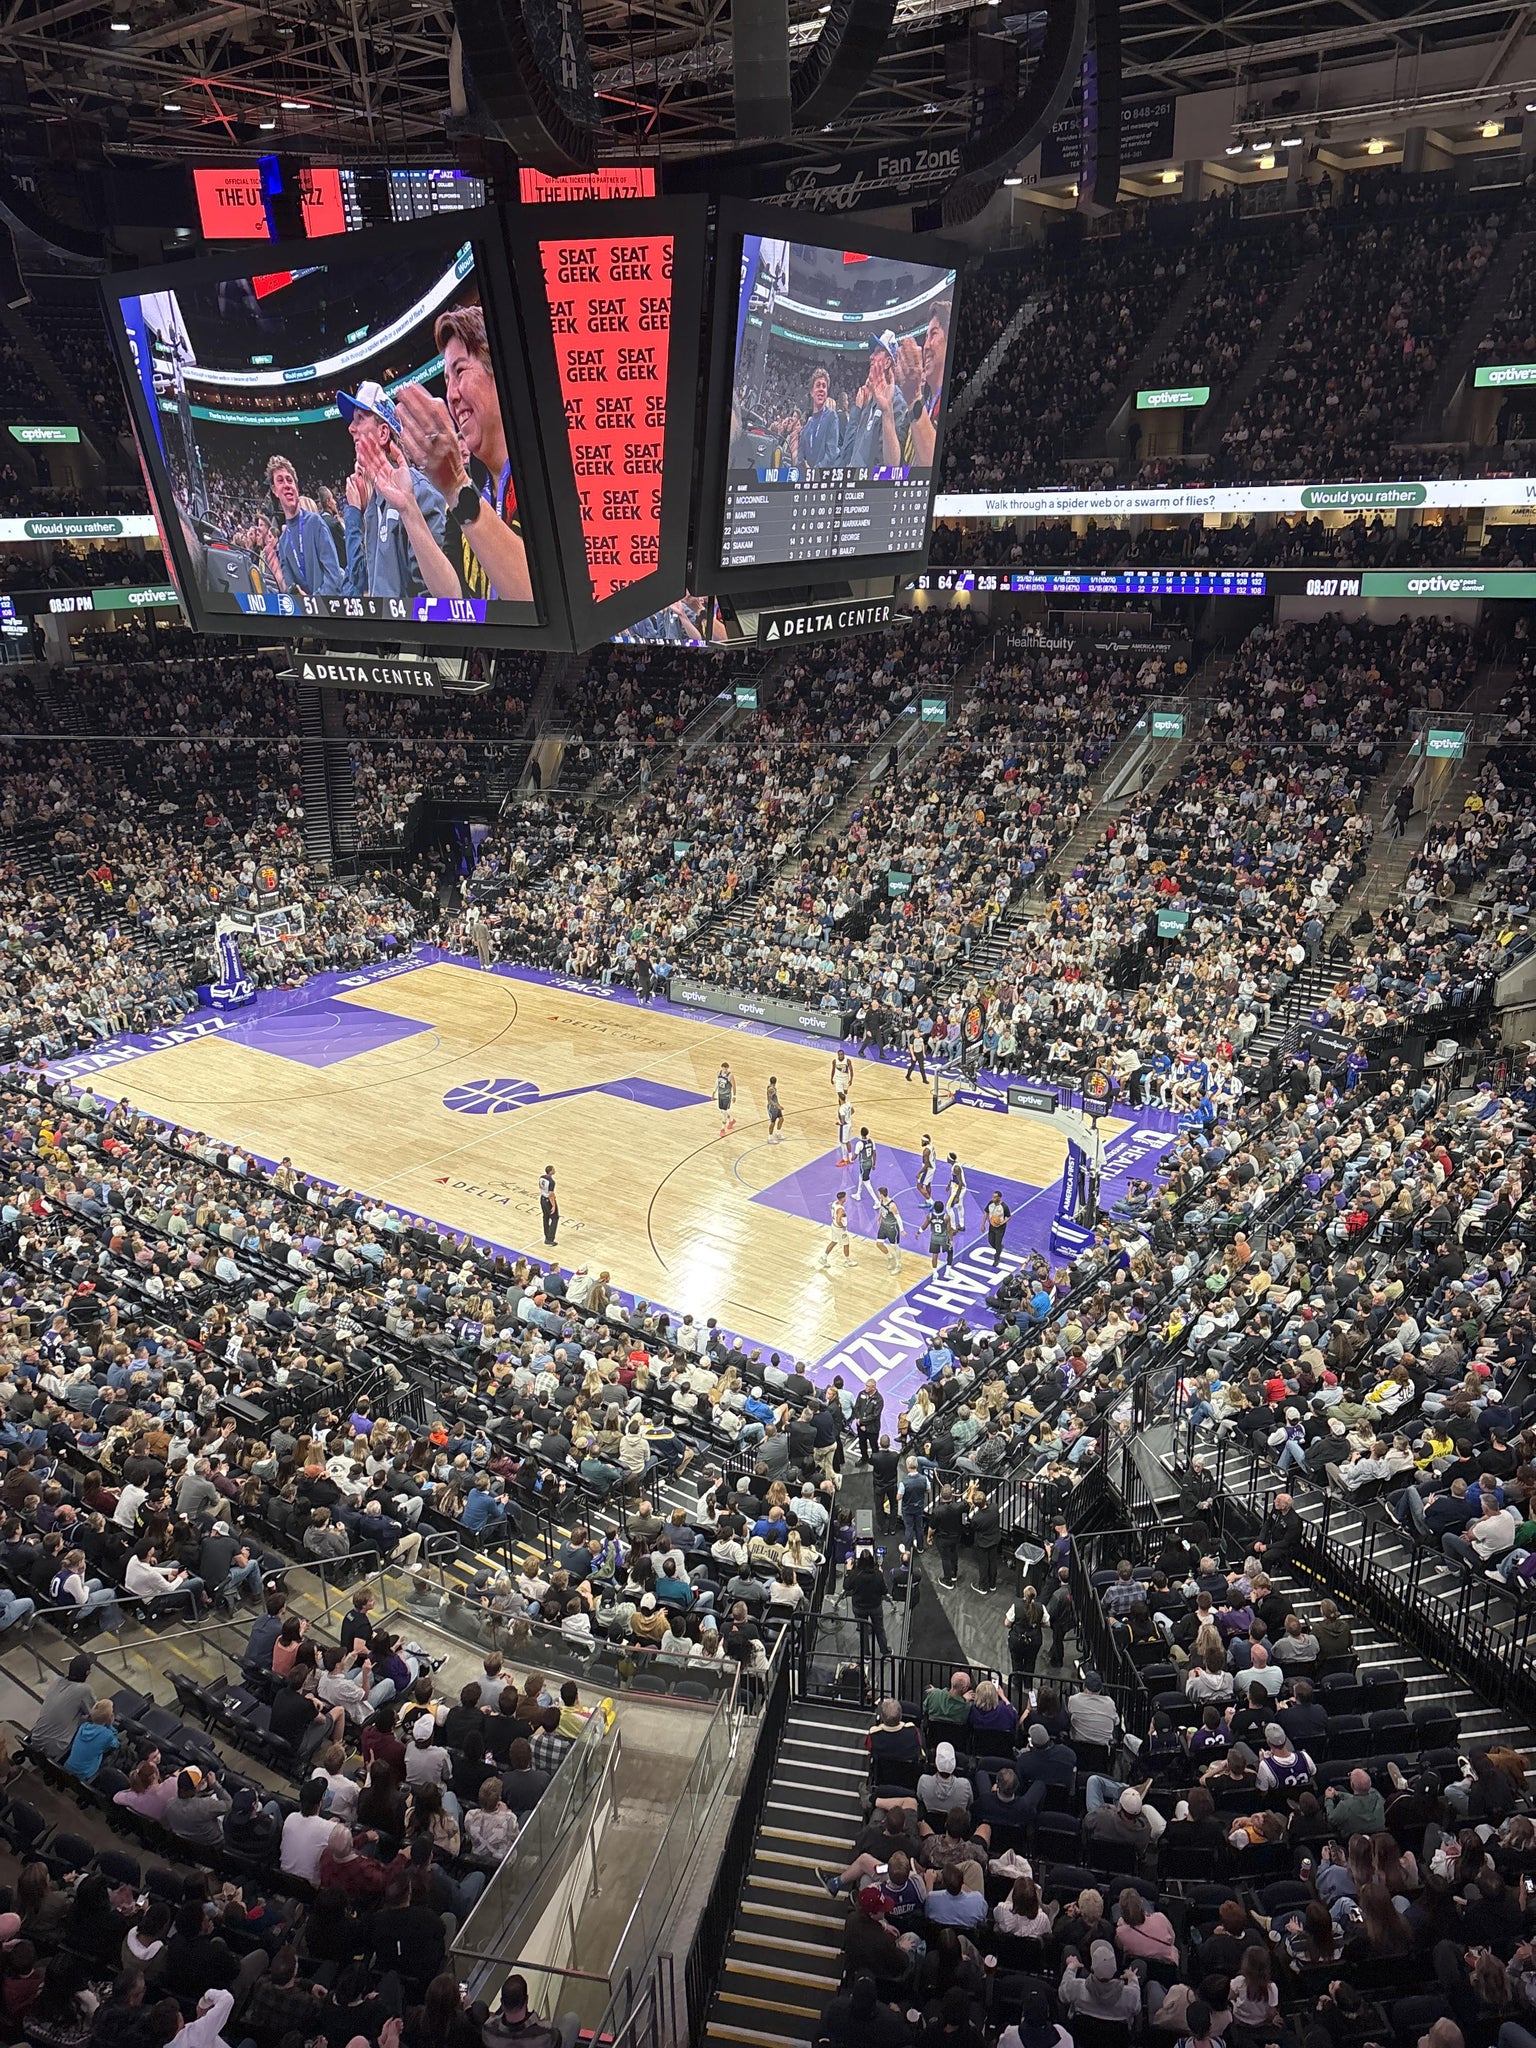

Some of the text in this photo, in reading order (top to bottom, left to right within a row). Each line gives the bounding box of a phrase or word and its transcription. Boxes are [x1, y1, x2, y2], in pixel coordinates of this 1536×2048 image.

[556, 0, 577, 90] TAH
[1133, 104, 1170, 118] 848-261
[1052, 120, 1068, 132] EXT
[878, 148, 960, 177] Fan Zone
[215, 188, 245, 206] THE
[559, 248, 597, 265] SEAT
[610, 246, 648, 263] SEAT
[558, 266, 600, 283] GEEK
[609, 264, 652, 281] GEEK
[588, 299, 626, 315] SEAT
[551, 315, 669, 333] EEK GEEK GEE
[567, 348, 655, 365] SEAT SEAT
[566, 365, 658, 382] GEEK GEEK
[1489, 368, 1529, 384] aptive
[565, 396, 664, 413] AT SEAT SE
[1147, 391, 1180, 406] aptive
[567, 413, 665, 430] EK GEEK GE
[22, 429, 53, 440] aptive
[575, 443, 661, 460] SEAT SEAT
[574, 460, 662, 475] GEEK GEEK
[765, 469, 778, 482] IND
[806, 469, 815, 481] 51
[832, 468, 843, 480] 2:35
[859, 468, 868, 480] 64
[891, 467, 903, 480] UTA
[603, 490, 638, 504] SEAT
[736, 492, 864, 504] MCCONNELL COLLIER
[986, 499, 1008, 510] Walk
[1010, 498, 1047, 511] through
[1057, 497, 1089, 510] spider
[1090, 497, 1112, 507] web
[1113, 499, 1125, 507] or
[1126, 499, 1133, 507] a
[1135, 498, 1171, 507] swarm
[1173, 496, 1184, 506] of
[1186, 495, 1215, 506] flies?
[1311, 490, 1416, 504] Would you rather:
[602, 506, 642, 520] GEEK
[735, 511, 756, 519] MARTIN
[844, 506, 869, 514] FILIPOWSKI
[32, 523, 116, 535] Would you rather:
[724, 519, 871, 535] 22 JACKSON MARKKANEN
[585, 535, 618, 549] SEAT
[733, 541, 754, 549] SIAKAM
[841, 533, 860, 541] GEORGE
[630, 551, 658, 564] GEE
[722, 547, 855, 565] 23 NESMITH BAILEY
[919, 576, 997, 590] 51 64 2:35
[1306, 579, 1359, 596] 08:07 PM
[1408, 576, 1459, 593] aptive
[50, 596, 93, 612] 08:07 PM
[129, 590, 166, 604] aptive
[248, 595, 476, 619] IND 51 2ND 2:35 6 64 UTA
[784, 606, 890, 637] DELTA CENTER
[1007, 636, 1074, 651] HealthEquity
[318, 665, 434, 687] DELTA CENTER
[1155, 719, 1180, 730] aptive
[1429, 738, 1463, 749] aptive
[1160, 919, 1184, 931] aptive
[367, 959, 425, 978] HEALTH
[558, 979, 614, 997] PACS
[682, 991, 708, 1003] aptive
[738, 1002, 767, 1016] aptive
[798, 1015, 828, 1029] aptive
[562, 1018, 607, 1033] DELTA
[611, 1030, 667, 1047] CENTER
[45, 1016, 238, 1080] UTAH JAZZ
[1017, 1094, 1043, 1106] aptive
[1100, 1145, 1150, 1181] HEALTH
[1063, 1155, 1076, 1211] AMERICA FIRST
[452, 1181, 512, 1206] DELTA
[515, 1202, 586, 1230] CEER
[934, 1223, 942, 1233] 8
[823, 1246, 1027, 1384] UTAH JAZZ
[226, 1347, 235, 1358] 24
[752, 1544, 779, 1562] BEL-AIR
